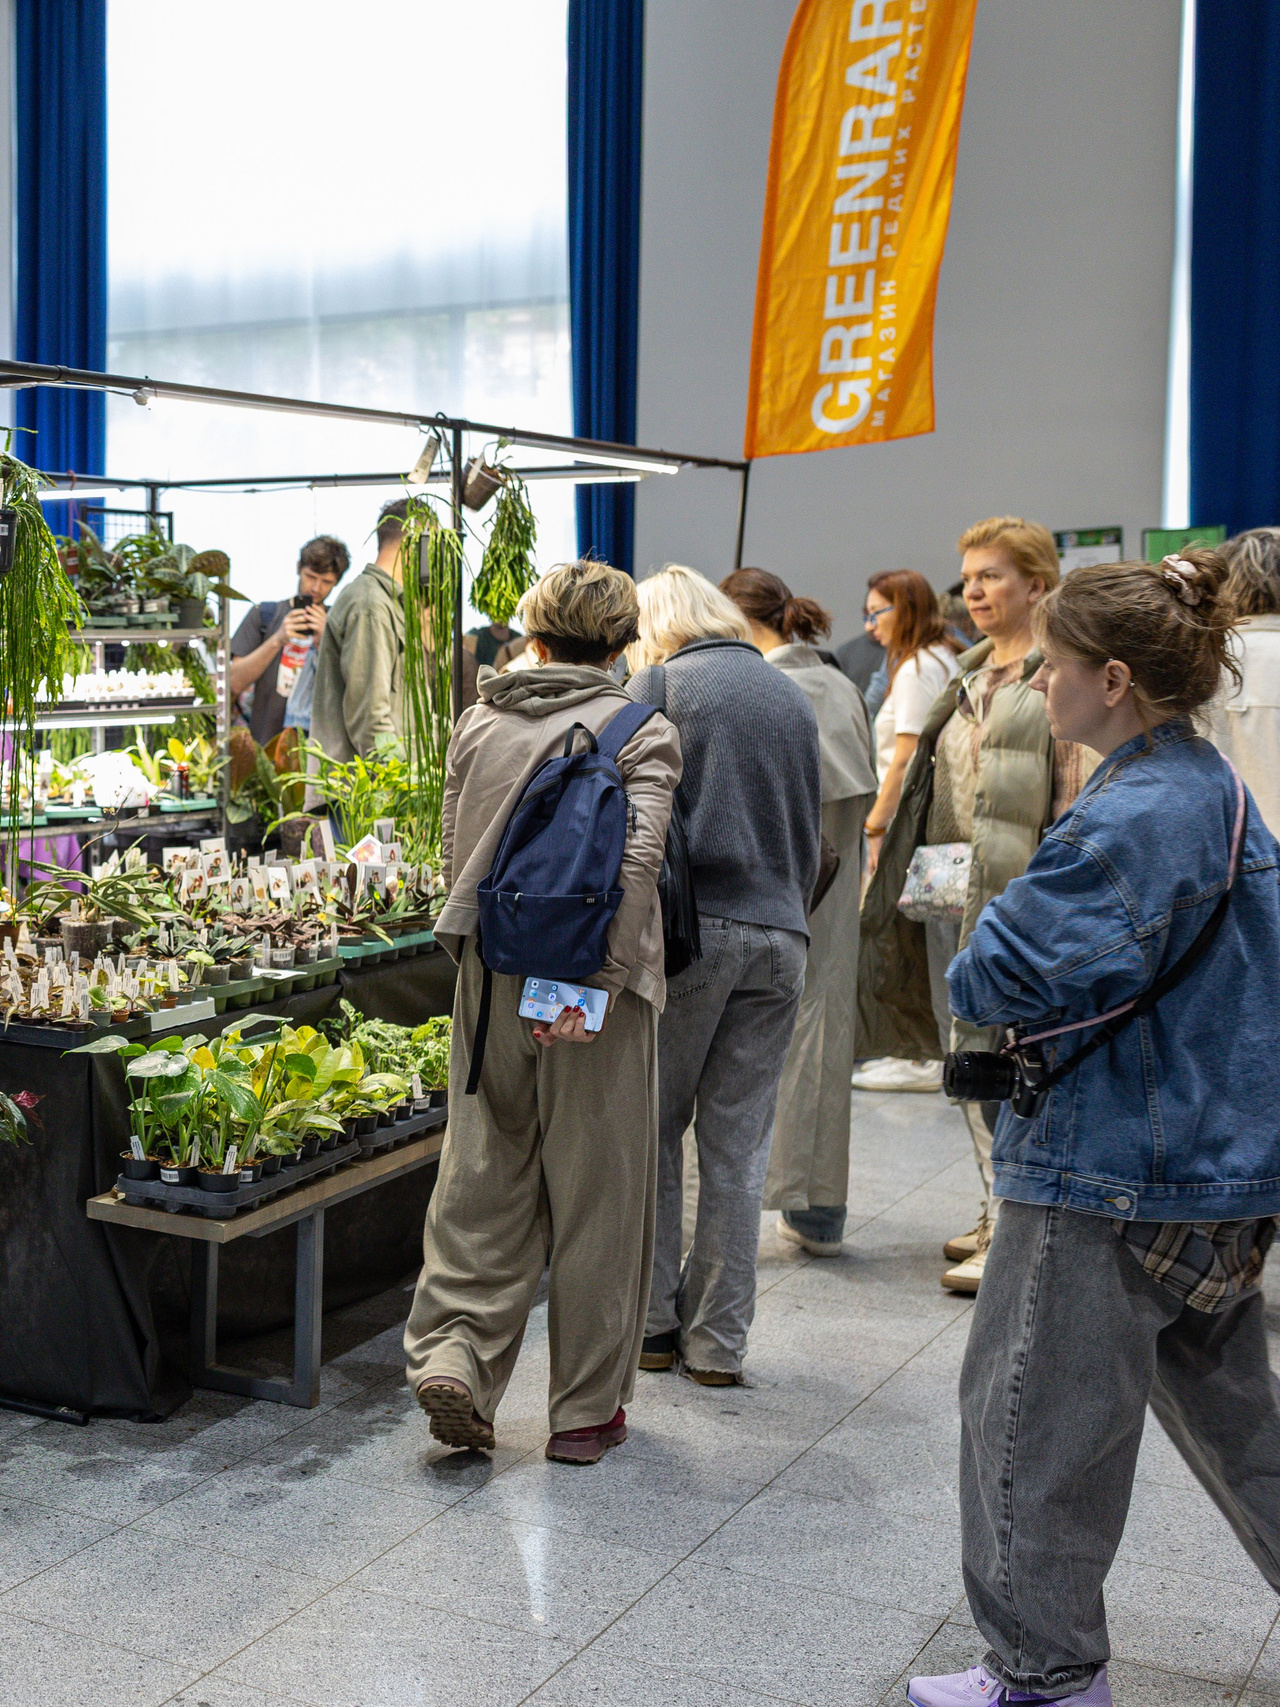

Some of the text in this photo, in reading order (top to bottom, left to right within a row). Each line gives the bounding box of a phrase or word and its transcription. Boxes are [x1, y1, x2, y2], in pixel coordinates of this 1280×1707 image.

[811, 0, 903, 434] GREENRAR
[882, 126, 911, 258] РЕДКИХ
[871, 280, 897, 427] МАГАЗИН
